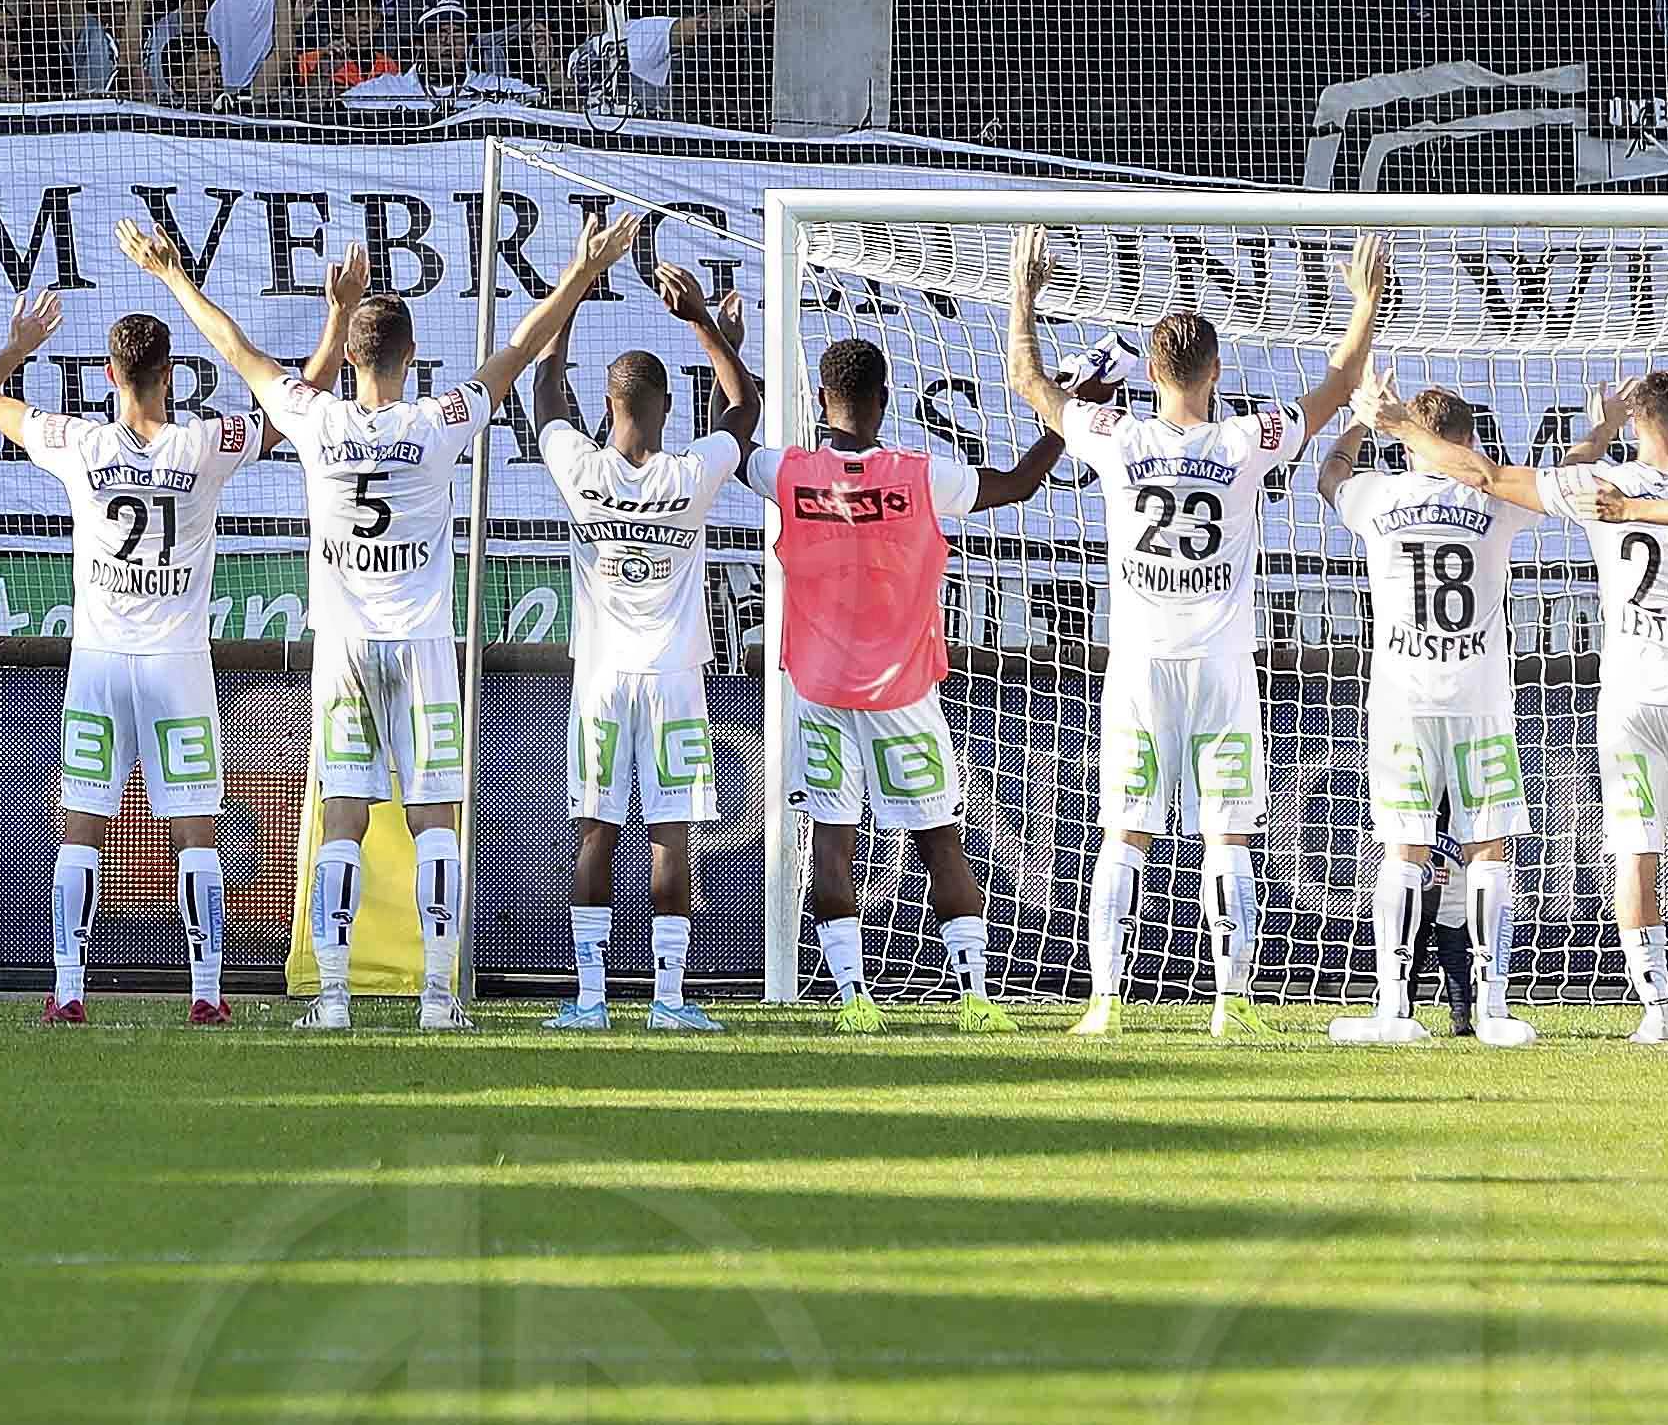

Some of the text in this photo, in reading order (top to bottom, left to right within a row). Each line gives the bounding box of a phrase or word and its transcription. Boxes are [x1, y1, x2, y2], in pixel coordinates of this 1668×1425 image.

[89, 465, 198, 494] PUNTIGAMER
[350, 472, 393, 539] 5
[603, 496, 691, 515] LOTTO
[1134, 485, 1226, 562] 23
[1373, 505, 1492, 536] PUNTIGAMER
[105, 494, 178, 567] 21
[574, 522, 699, 550] PUNTIGAMER
[1401, 542, 1478, 635] 18
